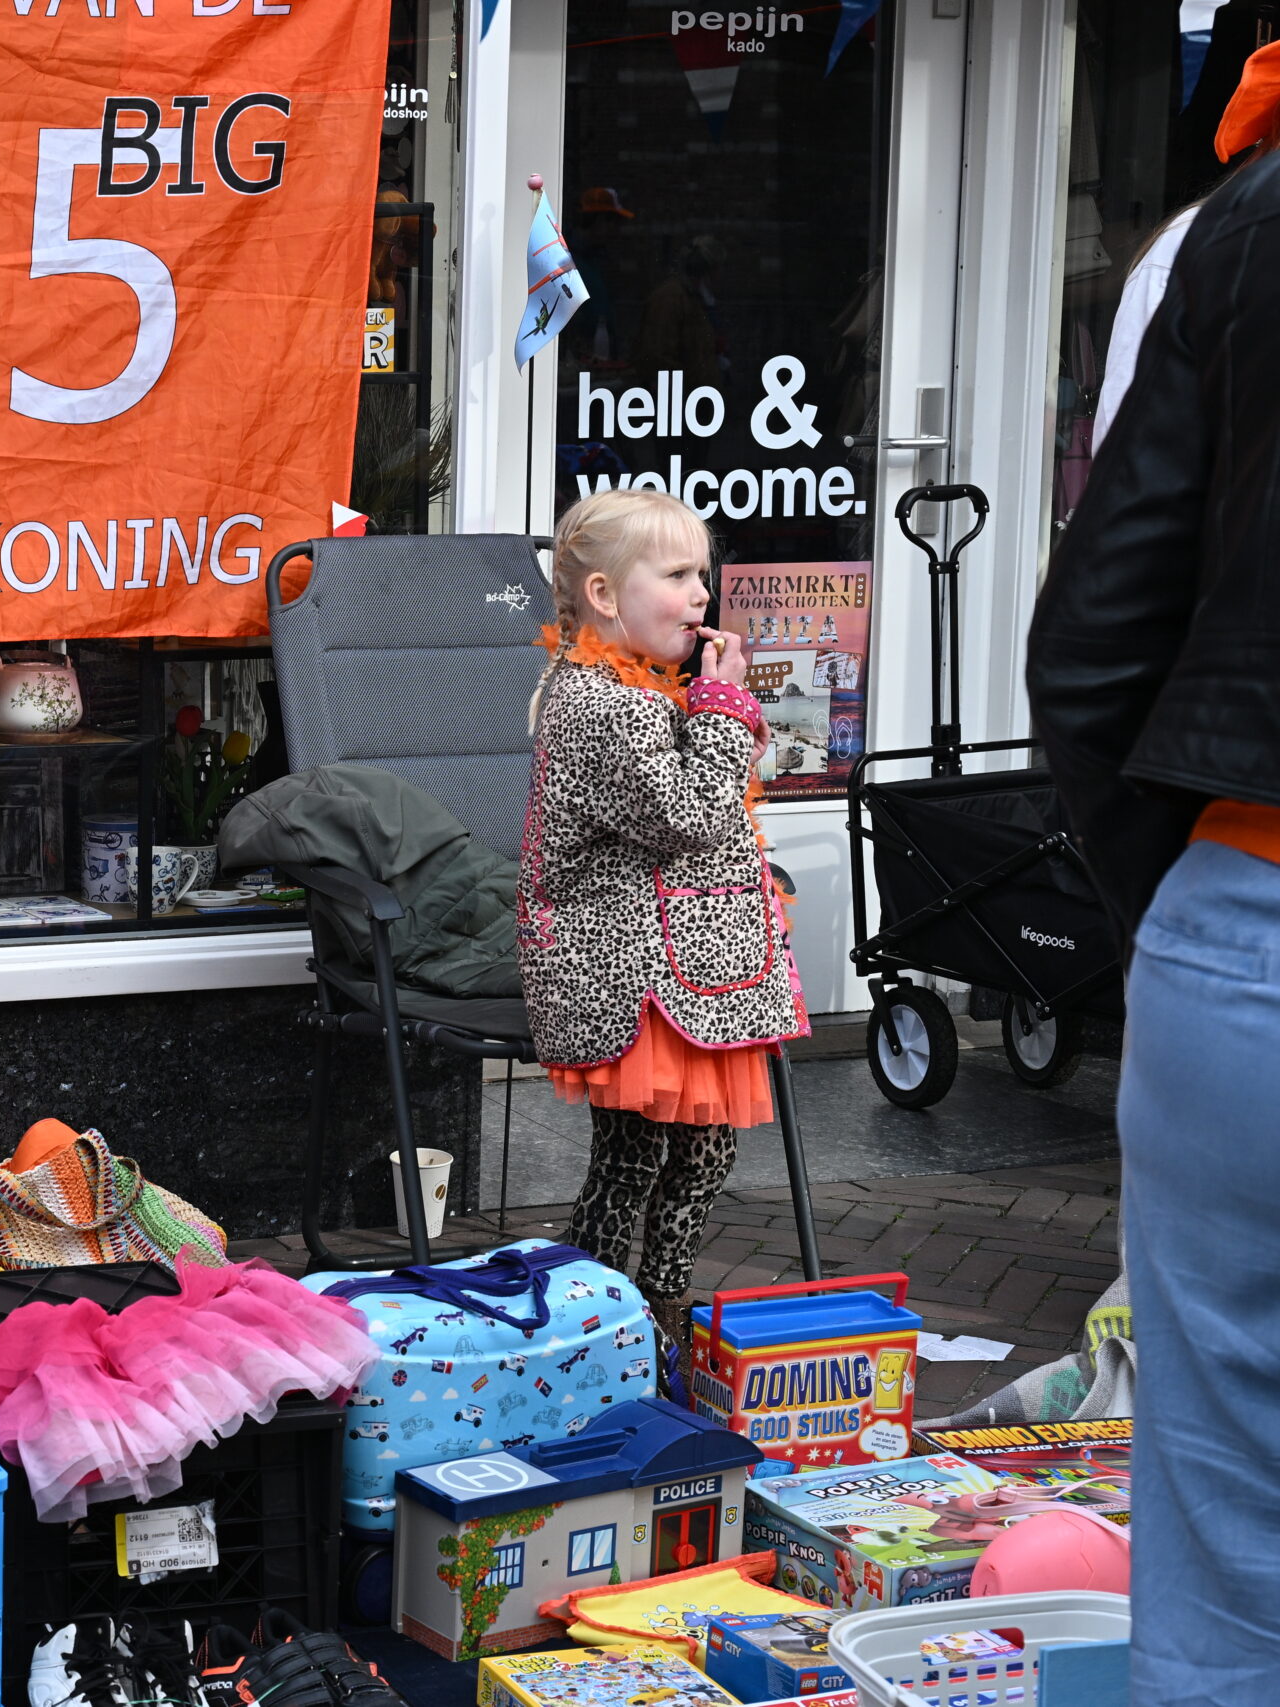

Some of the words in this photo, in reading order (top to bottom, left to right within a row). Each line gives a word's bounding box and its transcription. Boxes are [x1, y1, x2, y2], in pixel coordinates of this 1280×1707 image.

[671, 6, 803, 38] pepijn
[727, 38, 765, 52] kado
[384, 84, 428, 107] ijn
[96, 92, 291, 197] BIG
[9, 128, 182, 424] 5
[578, 370, 725, 438] hello
[750, 355, 823, 450] &
[730, 575, 854, 595] ZMRMRKT
[728, 595, 850, 610] VOORSCHOTEN
[747, 615, 838, 645] IBIZA
[758, 678, 780, 687] MEI
[1021, 925, 1075, 950] lifegoods
[693, 1370, 733, 1415] DOMINO
[741, 1355, 872, 1410] DOMINO
[749, 1416, 791, 1442] 600
[797, 1408, 860, 1437] STUKS
[927, 1426, 1040, 1448] DOMINO
[964, 1444, 1053, 1455] AMAZING
[660, 1479, 716, 1501] POLICE
[806, 1473, 900, 1499] POEPIE
[860, 1479, 946, 1501] KNOR
[746, 1522, 786, 1545] POEPIE
[789, 1542, 825, 1566] KNOR
[142, 1560, 155, 1568] HD
[160, 1558, 179, 1567] 90D
[711, 1632, 722, 1644] LEGO
[725, 1641, 742, 1658] CITY
[801, 1679, 817, 1688] LEGO
[822, 1675, 845, 1688] CITY
